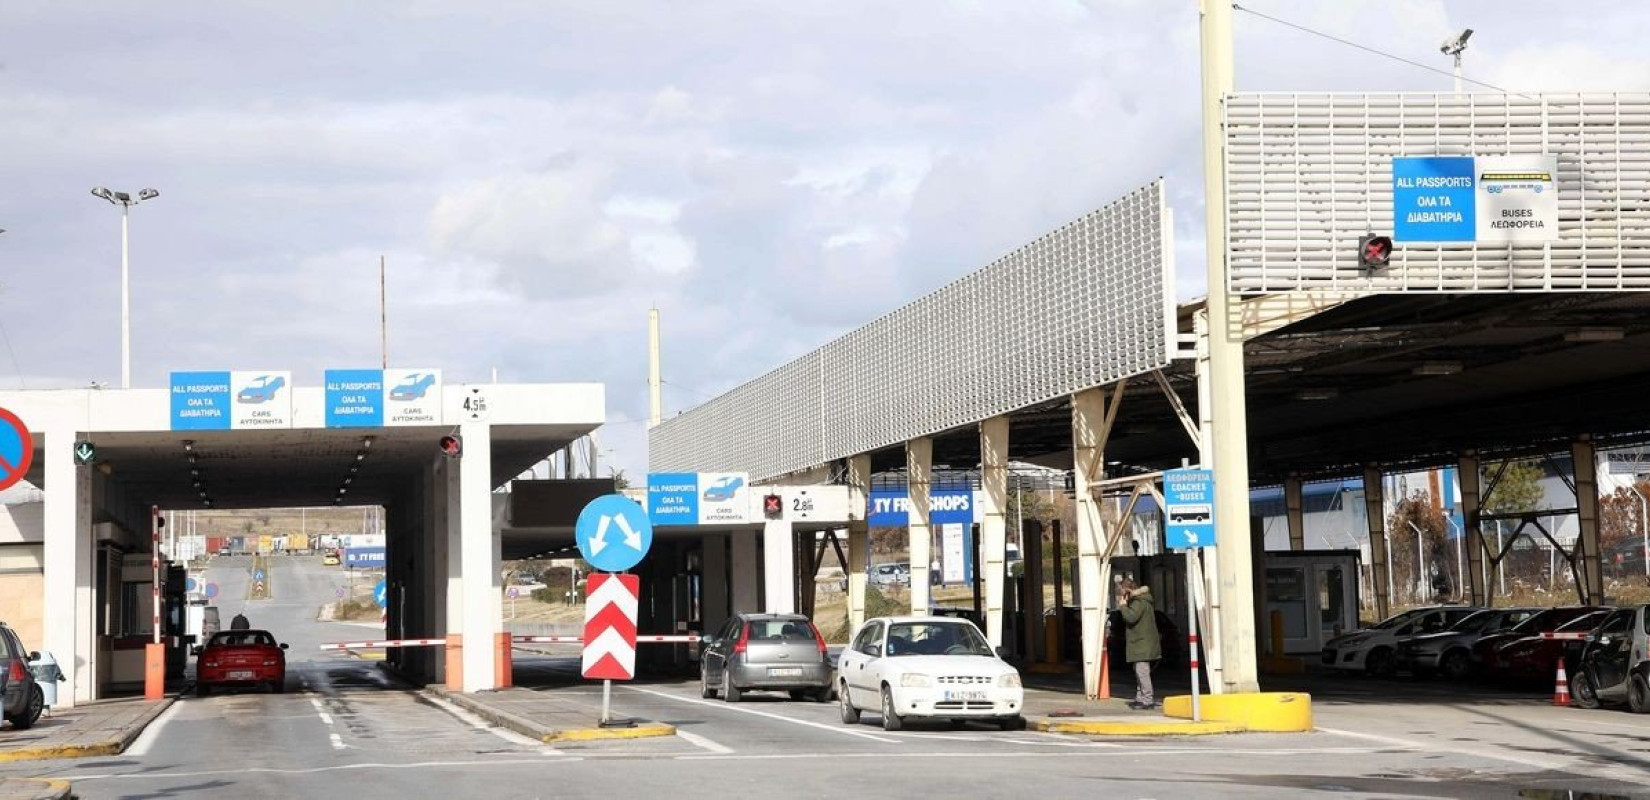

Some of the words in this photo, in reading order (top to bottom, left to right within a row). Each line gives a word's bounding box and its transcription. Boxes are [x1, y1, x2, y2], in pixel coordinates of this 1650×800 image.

[1397, 177, 1414, 188] ALL
[1416, 176, 1472, 188] PASSPORTS
[1416, 196, 1438, 207] ΟΛΑ
[1439, 196, 1451, 207] ΤΑ
[1407, 212, 1463, 223] ΔΙΑΒΑΤΗΡΙΑ
[1502, 209, 1533, 218] BUSES
[1491, 220, 1545, 229] ΛΕΩΦΟΡΕΙΑ
[172, 385, 185, 394] ALL
[186, 384, 228, 393] PASSPORTS
[328, 382, 341, 390] ALL
[341, 381, 382, 390] PASSPORTS
[204, 398, 214, 406] ΤΑ
[357, 395, 367, 403] ΤΑ
[251, 410, 271, 418] CARS
[661, 484, 696, 492] PASSPORTS
[1171, 482, 1207, 492] COACHES
[873, 497, 892, 513] TY
[892, 497, 909, 513] FR
[928, 494, 970, 512] SHOPS
